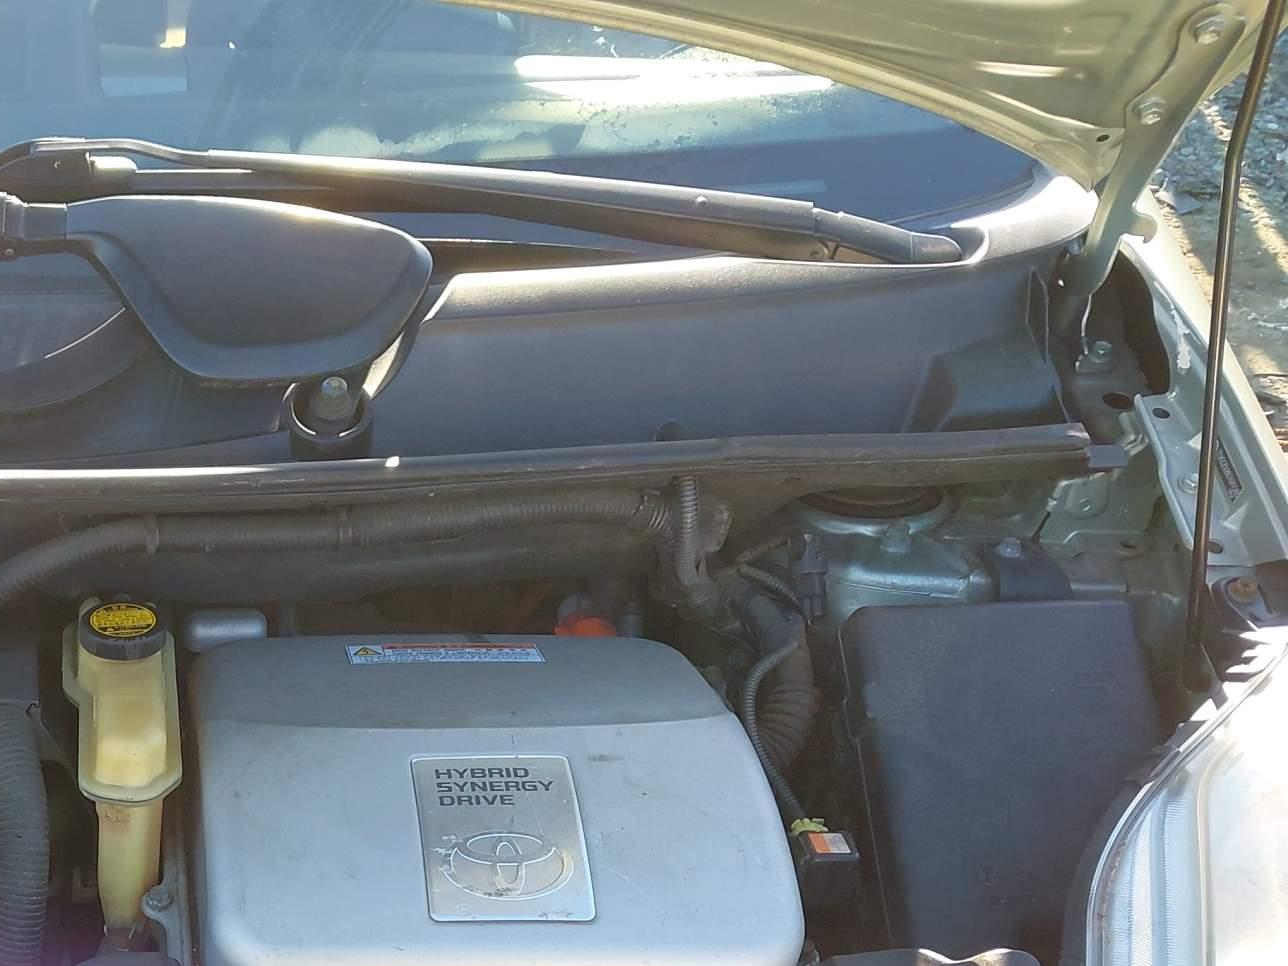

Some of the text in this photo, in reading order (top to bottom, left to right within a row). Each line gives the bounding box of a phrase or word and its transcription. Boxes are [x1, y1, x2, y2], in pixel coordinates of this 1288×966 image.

[434, 767, 530, 779] HYBRID
[436, 780, 554, 793] SYNERGY
[439, 794, 515, 806] DRIVE
